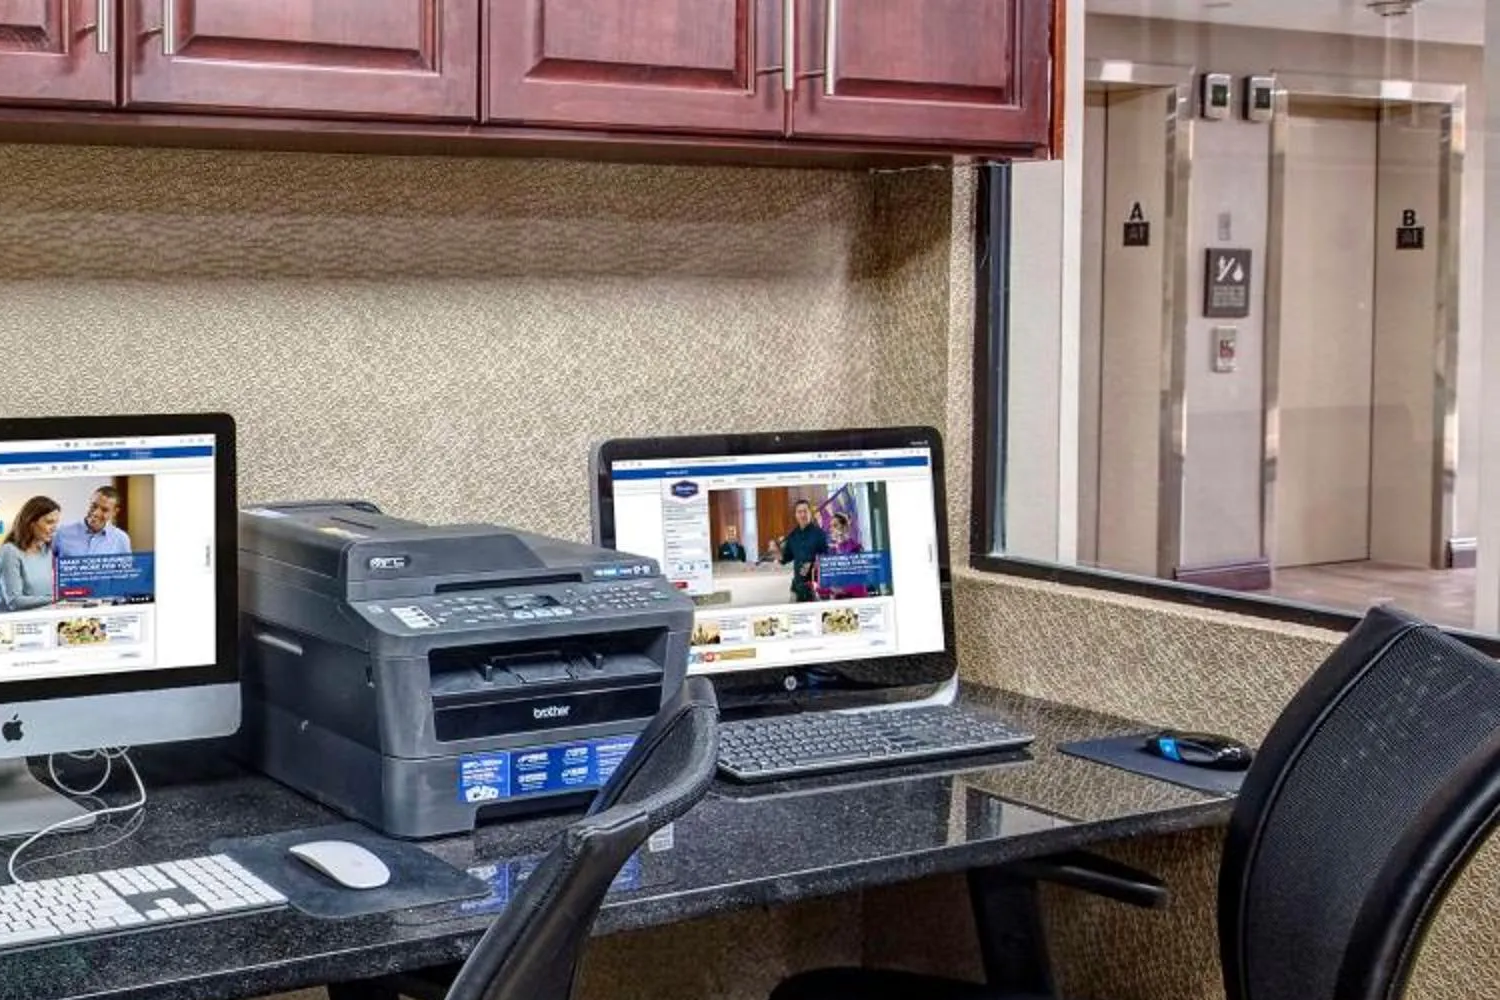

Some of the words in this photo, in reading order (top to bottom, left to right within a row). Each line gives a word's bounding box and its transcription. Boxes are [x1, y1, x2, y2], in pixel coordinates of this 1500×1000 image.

[1129, 201, 1144, 221] A
[1402, 209, 1417, 227] B
[533, 705, 571, 719] brother
